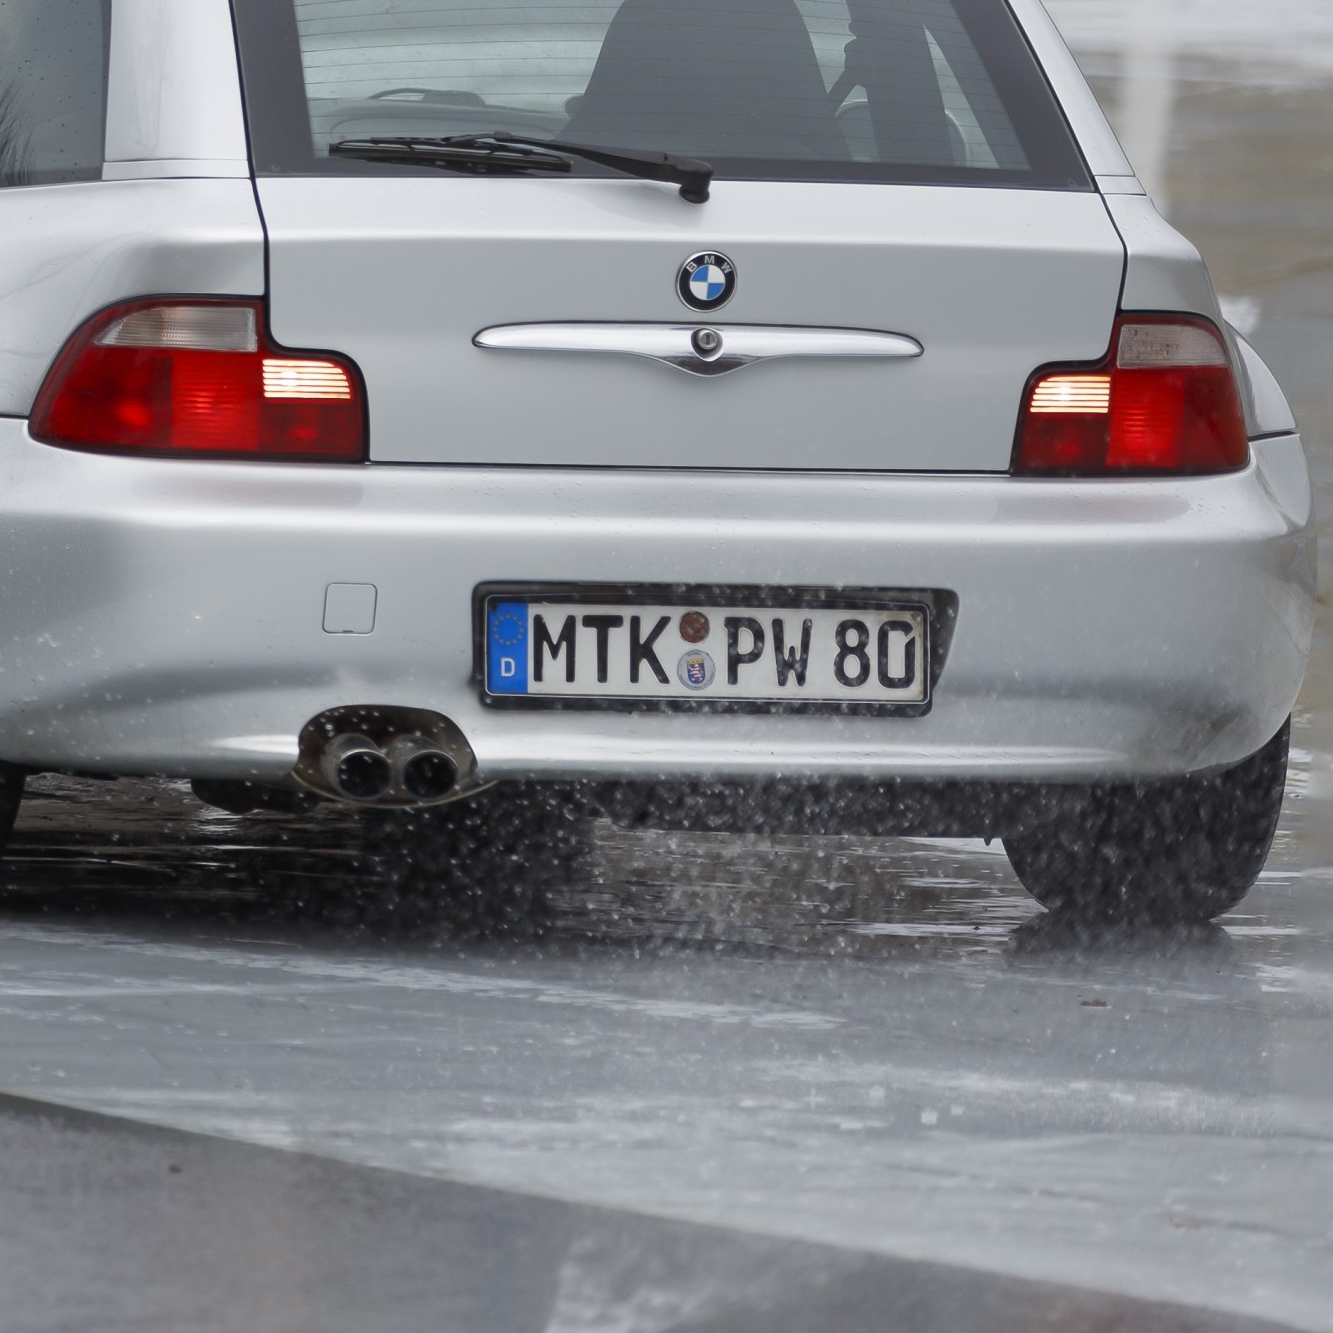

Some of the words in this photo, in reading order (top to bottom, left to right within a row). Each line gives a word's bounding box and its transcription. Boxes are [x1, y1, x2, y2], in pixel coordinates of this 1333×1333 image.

[686, 255, 732, 274] BMW
[533, 614, 671, 684] MTK
[724, 617, 813, 687] PW
[834, 619, 917, 689] 80
